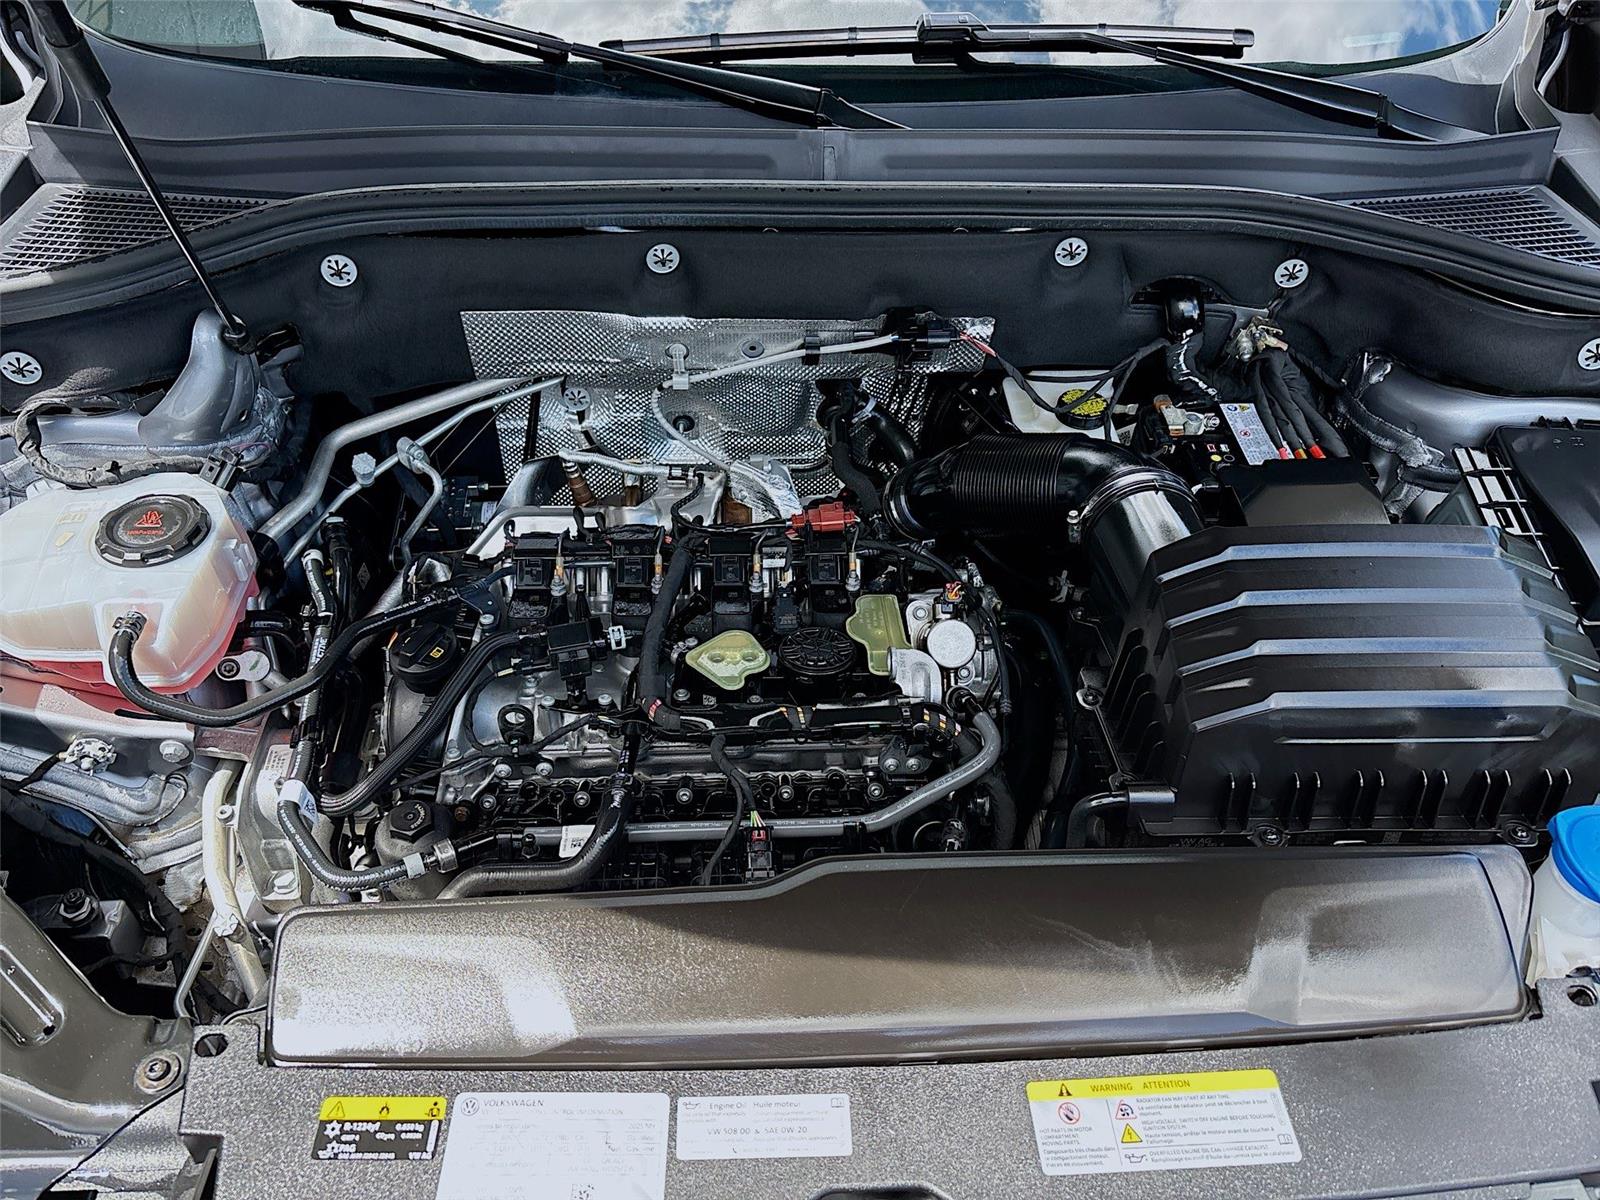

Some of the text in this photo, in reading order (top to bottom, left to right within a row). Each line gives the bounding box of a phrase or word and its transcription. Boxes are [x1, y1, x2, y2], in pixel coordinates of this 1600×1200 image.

[1090, 1080, 1190, 1093] WARNING ATTENTION
[710, 1103, 734, 1111] Engine
